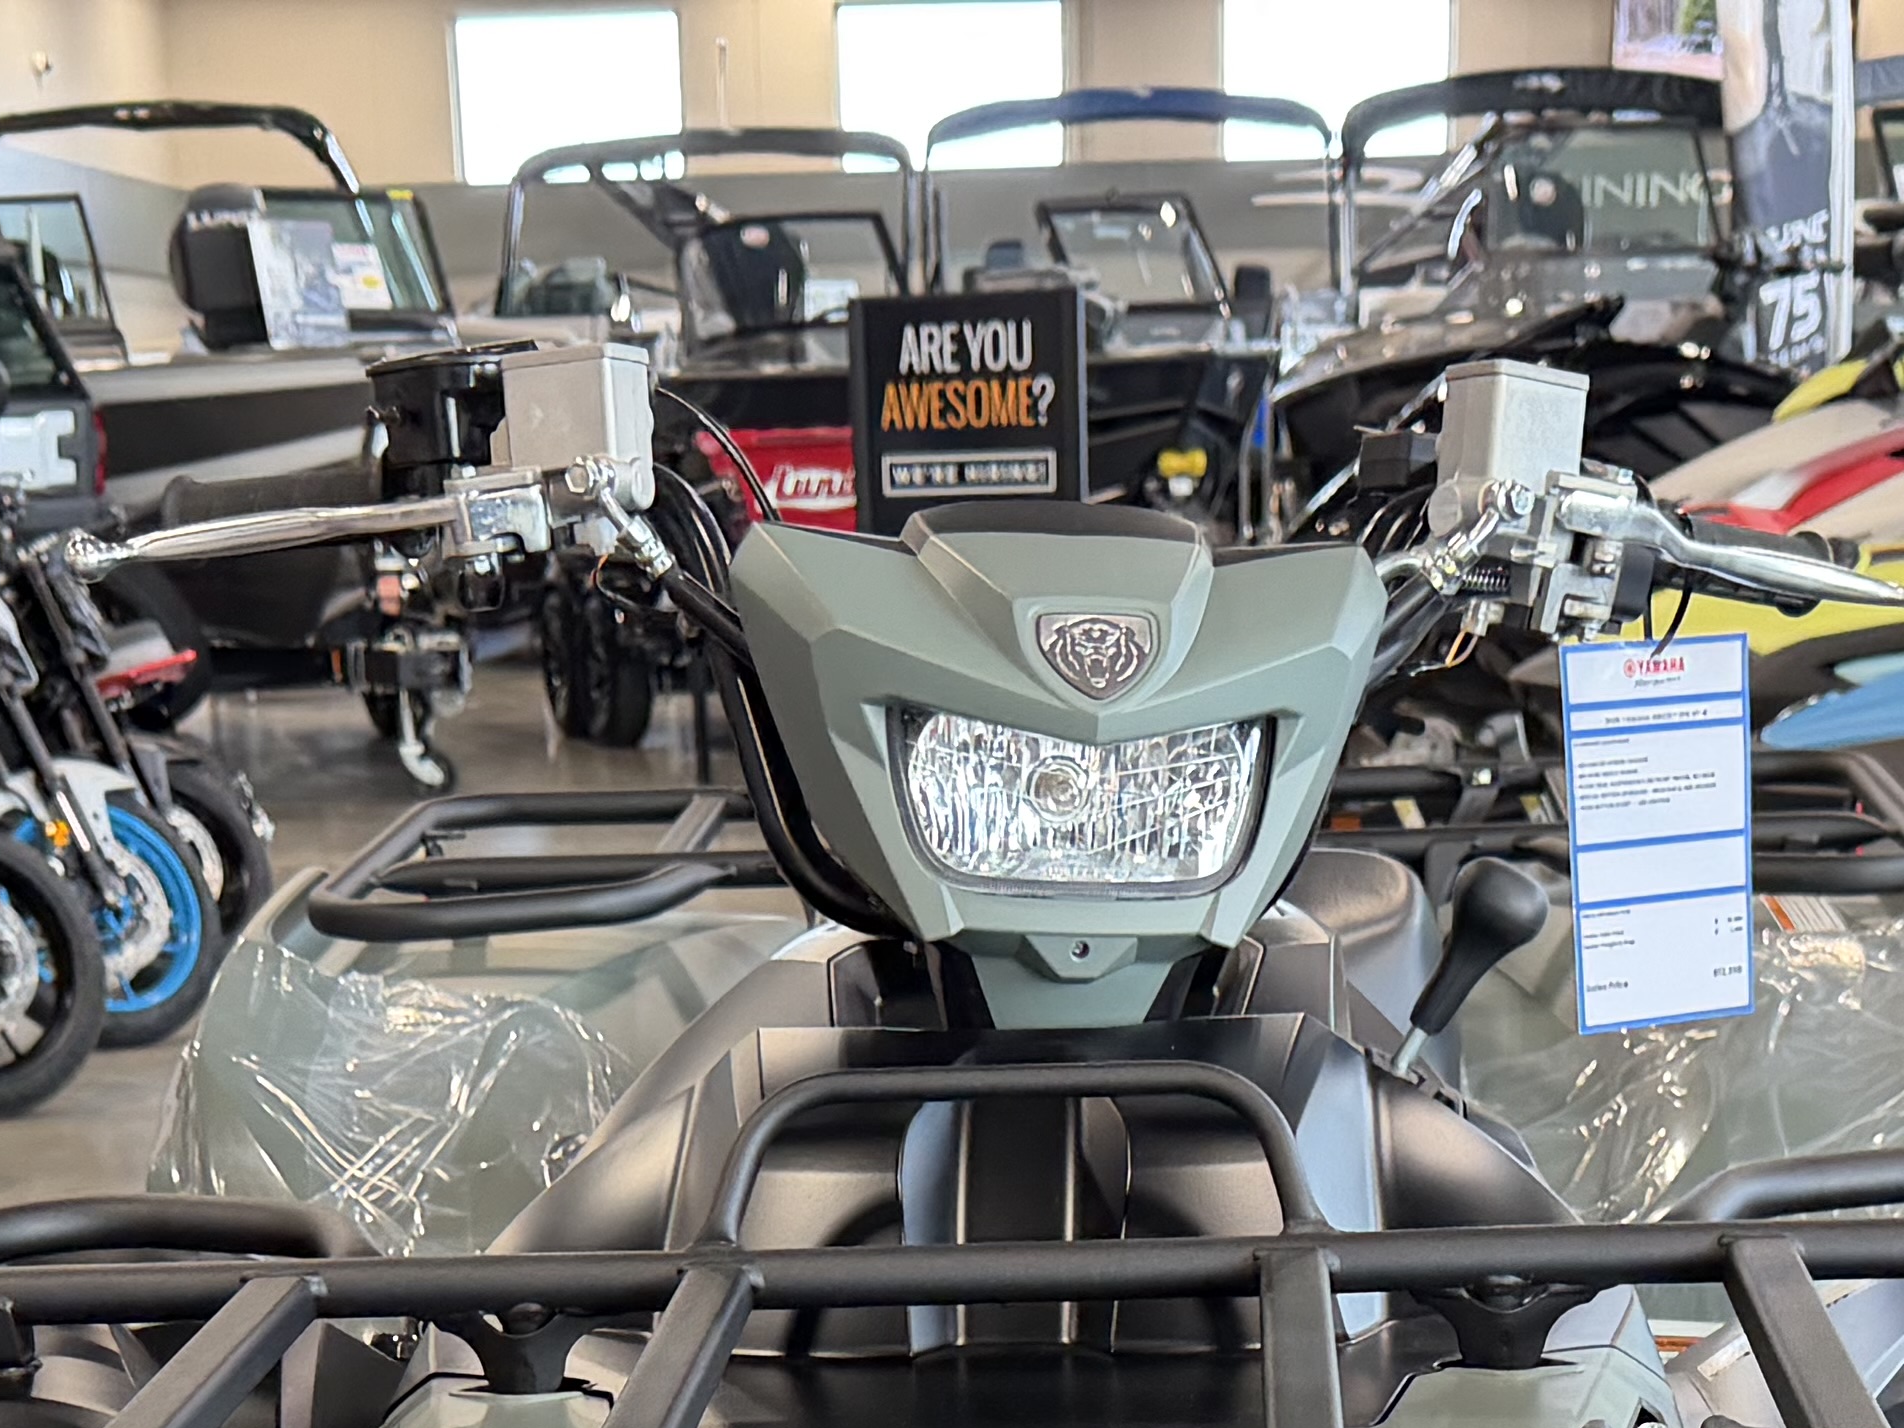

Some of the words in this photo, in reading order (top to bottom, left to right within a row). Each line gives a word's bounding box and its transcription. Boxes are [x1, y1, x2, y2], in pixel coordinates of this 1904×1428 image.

[1759, 268, 1823, 351] 75
[899, 320, 961, 375] ARE
[963, 317, 1033, 373] YOU
[881, 373, 1056, 432] AWESOME?
